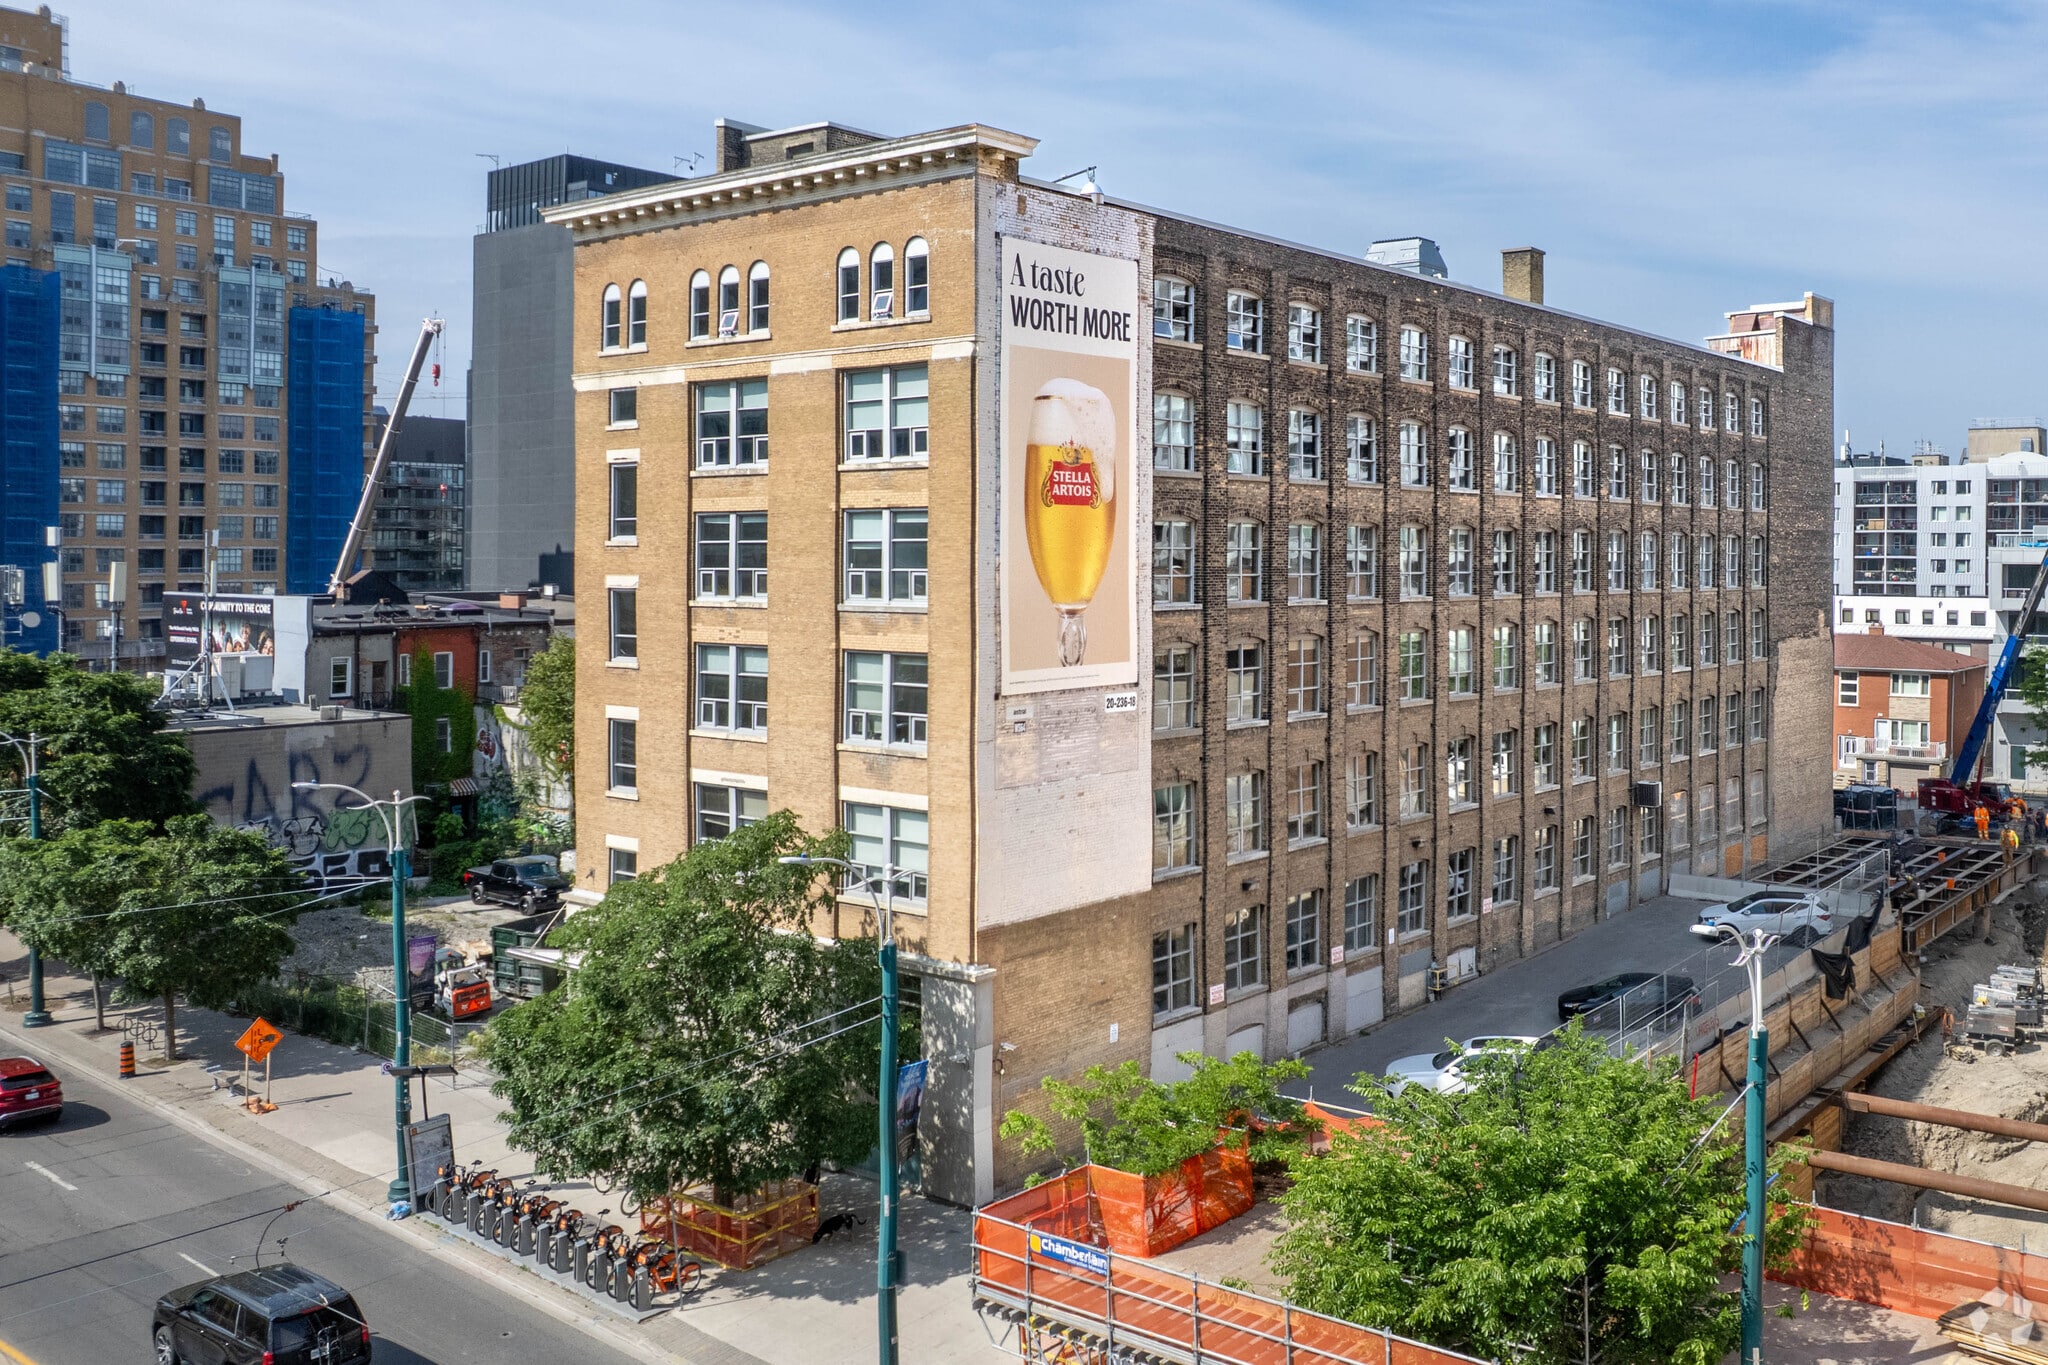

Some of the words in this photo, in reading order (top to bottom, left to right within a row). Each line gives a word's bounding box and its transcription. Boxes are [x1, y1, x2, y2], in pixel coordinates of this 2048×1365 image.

[1010, 252, 1026, 287] A
[1030, 259, 1085, 297] taste
[1010, 294, 1078, 335] WORTH
[1083, 306, 1131, 342] MORE
[1053, 470, 1091, 483] STELLA
[1052, 484, 1092, 497] ARTOIS
[243, 602, 255, 614] THE
[255, 603, 271, 614] CORE
[1041, 1238, 1107, 1269] Chamberlain
